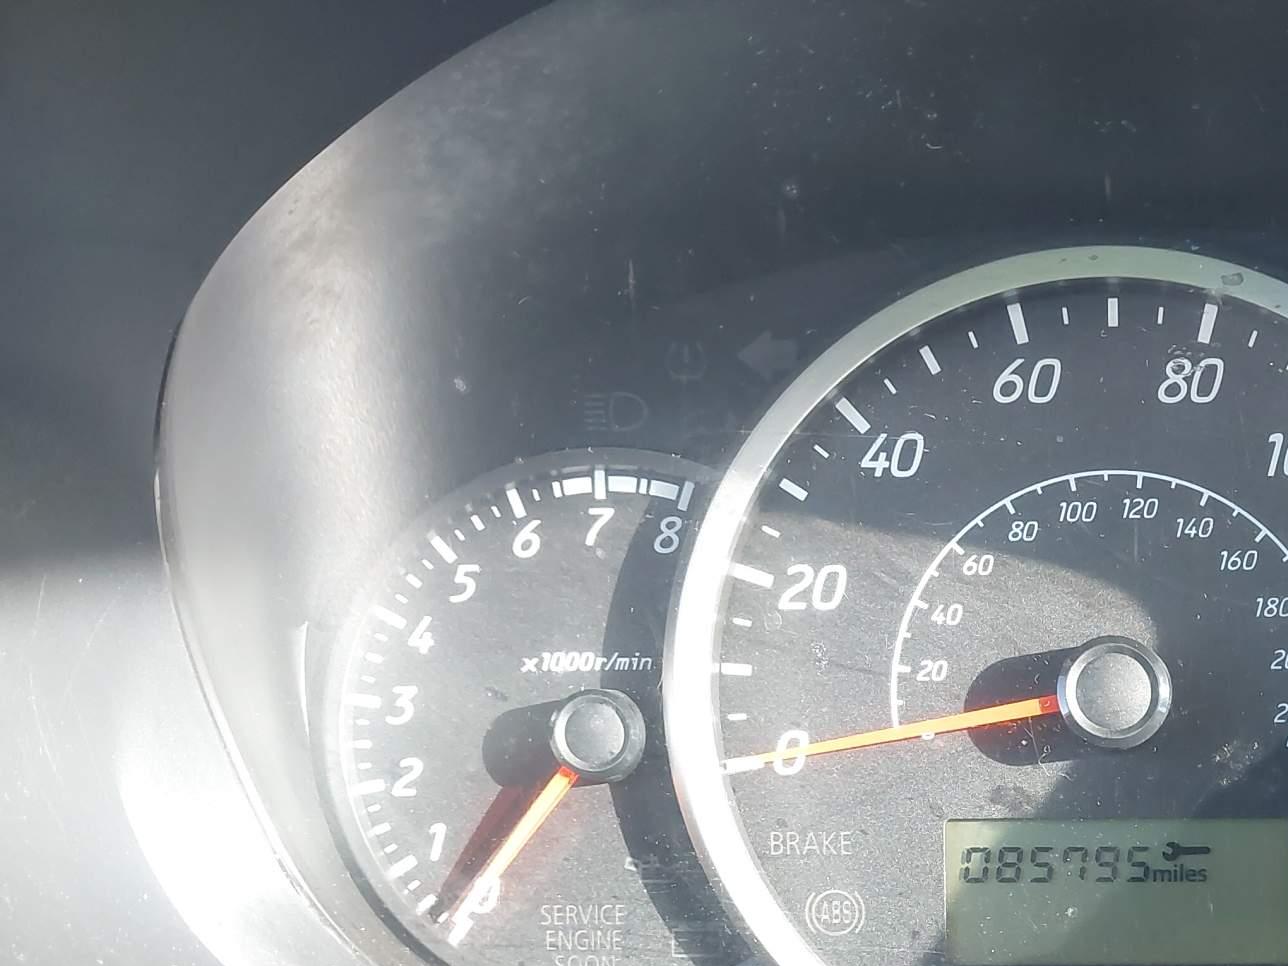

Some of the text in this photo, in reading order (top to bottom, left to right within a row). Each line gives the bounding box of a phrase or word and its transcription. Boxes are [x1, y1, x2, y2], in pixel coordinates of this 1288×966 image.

[993, 359, 1061, 403] 60
[1158, 358, 1223, 403] 80
[861, 432, 924, 477] 40
[1060, 502, 1096, 522] 100
[1123, 499, 1158, 518] 120
[513, 520, 541, 558] 6
[586, 508, 614, 546] 7
[654, 517, 682, 553] 8
[1009, 521, 1038, 541] 80
[1177, 518, 1213, 537] 140
[963, 555, 994, 575] 60
[1221, 551, 1257, 570] 160
[449, 565, 479, 603] 5
[778, 564, 846, 611] 20
[931, 604, 962, 625] 40
[408, 616, 434, 654] 4
[917, 660, 948, 681] 20
[386, 686, 417, 725] 3
[773, 730, 809, 777] 0
[391, 758, 423, 796] 2
[429, 823, 446, 861] 1
[770, 831, 852, 855] BRAKE
[963, 846, 1208, 883] 085795 miles
[540, 904, 625, 926] SERVICE
[821, 900, 852, 924] ABS
[545, 929, 623, 952] ENGINE
